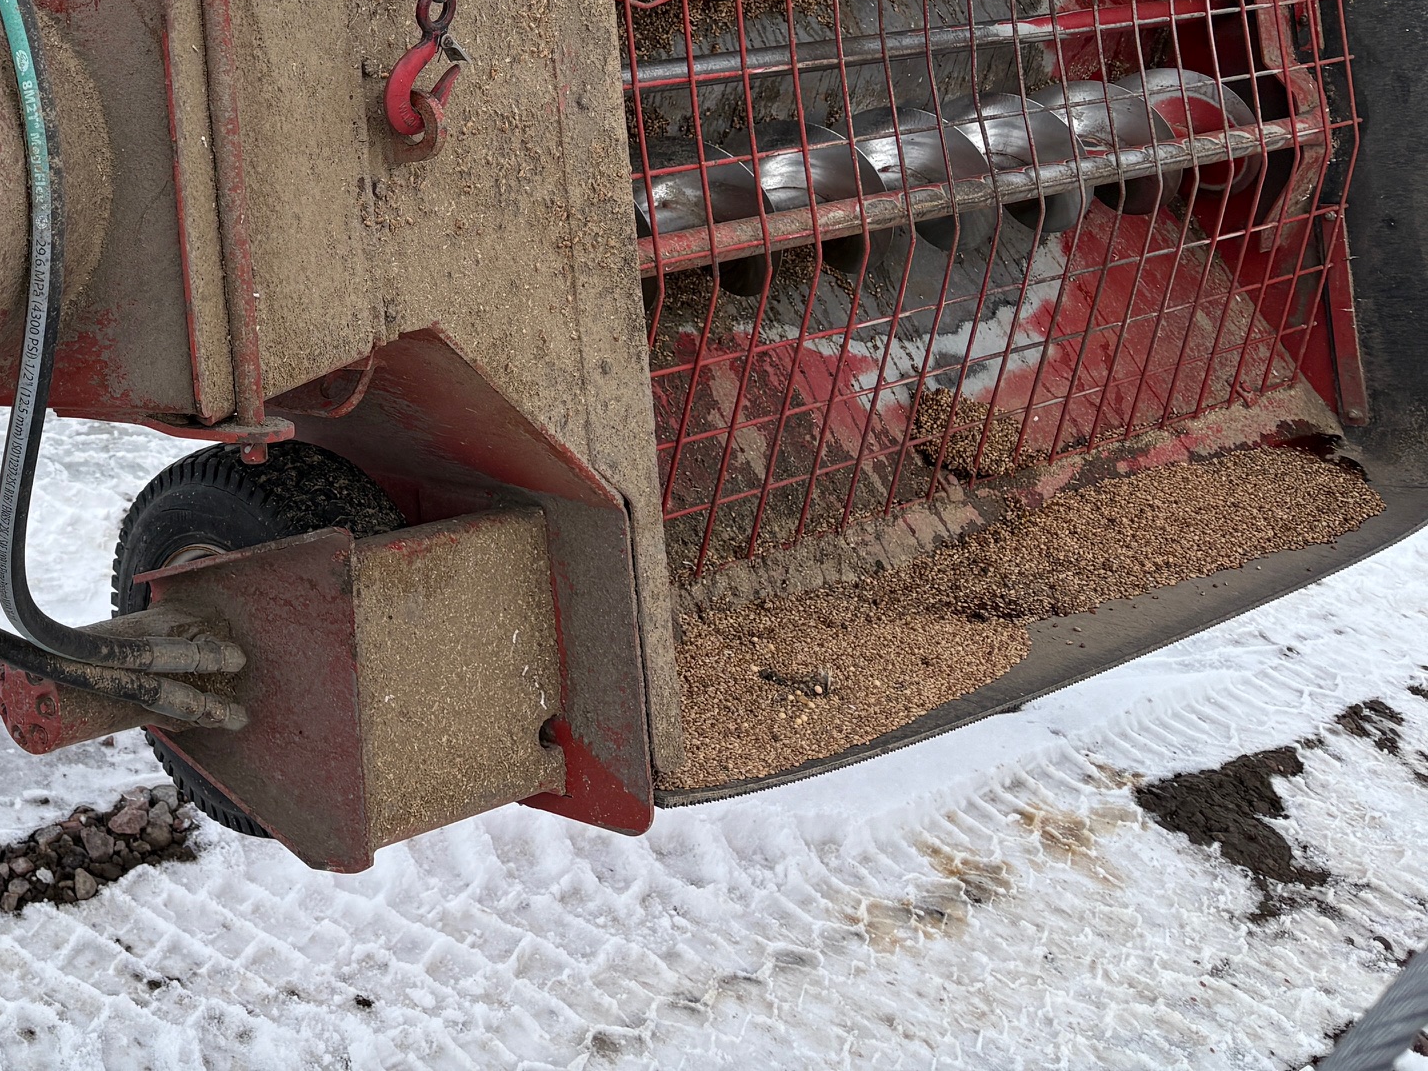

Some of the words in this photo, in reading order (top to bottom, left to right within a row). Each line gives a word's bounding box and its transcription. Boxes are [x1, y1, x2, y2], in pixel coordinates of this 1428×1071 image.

[33, 270, 45, 297] MPa
[29, 300, 43, 336] (4300
[25, 337, 40, 360] PSI)
[23, 363, 35, 387] 1/2"
[18, 386, 32, 415] (12.5
[13, 415, 25, 440] mm)
